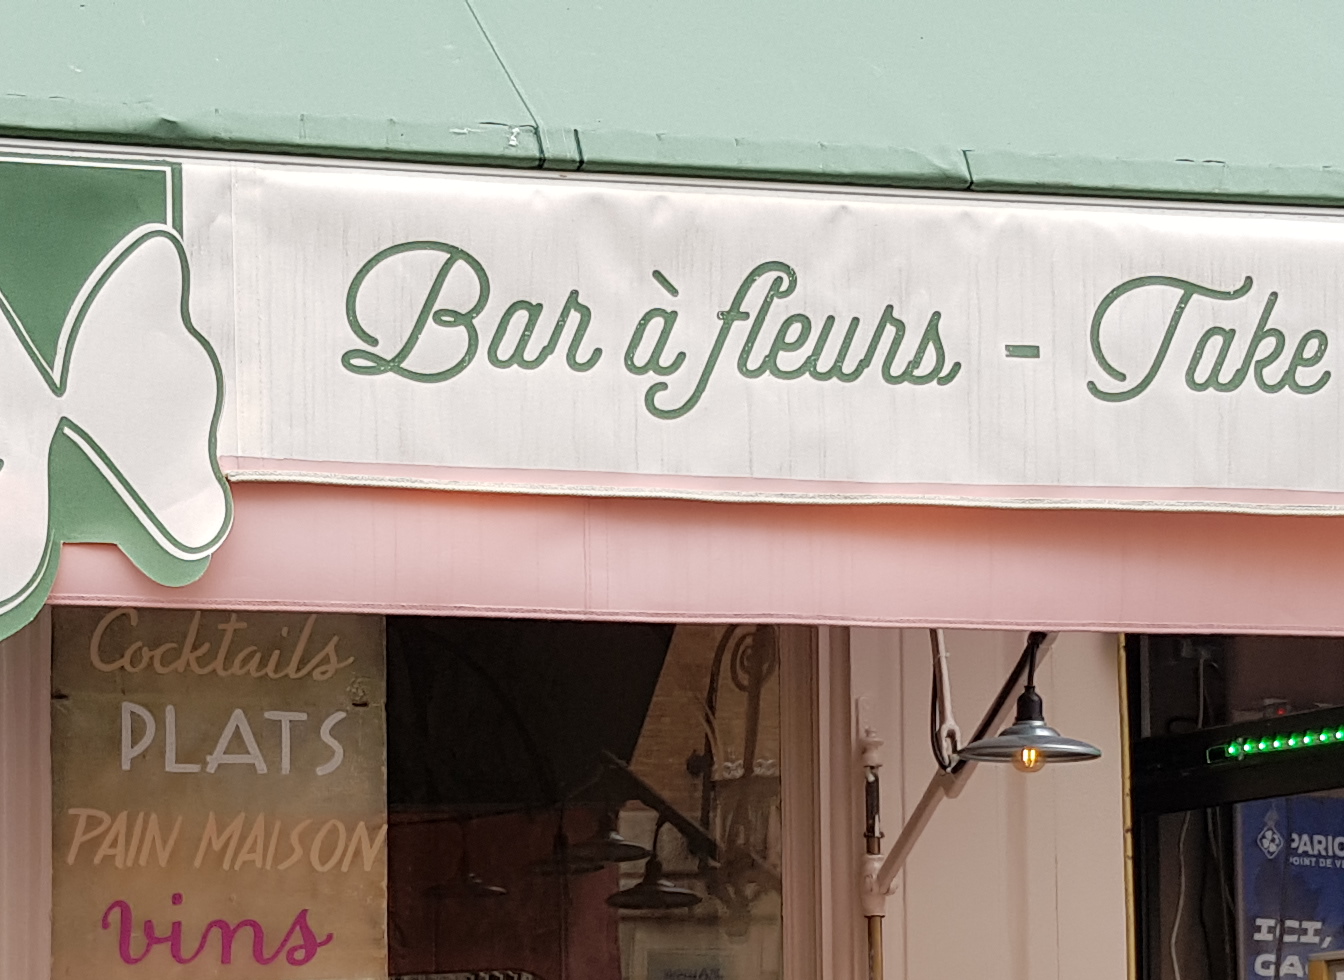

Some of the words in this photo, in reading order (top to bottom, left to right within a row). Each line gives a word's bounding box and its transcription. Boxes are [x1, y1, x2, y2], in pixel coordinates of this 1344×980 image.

[341, 239, 603, 384] Bar
[623, 268, 686, 376] à
[643, 259, 962, 420] fleurs
[1086, 275, 1332, 402] Take
[90, 607, 355, 682] Cocktails
[120, 700, 348, 776] PLATS
[66, 807, 183, 869] PAIN
[193, 810, 390, 874] MAISON
[1289, 855, 1316, 867] OINT
[1254, 952, 1309, 978] GA
